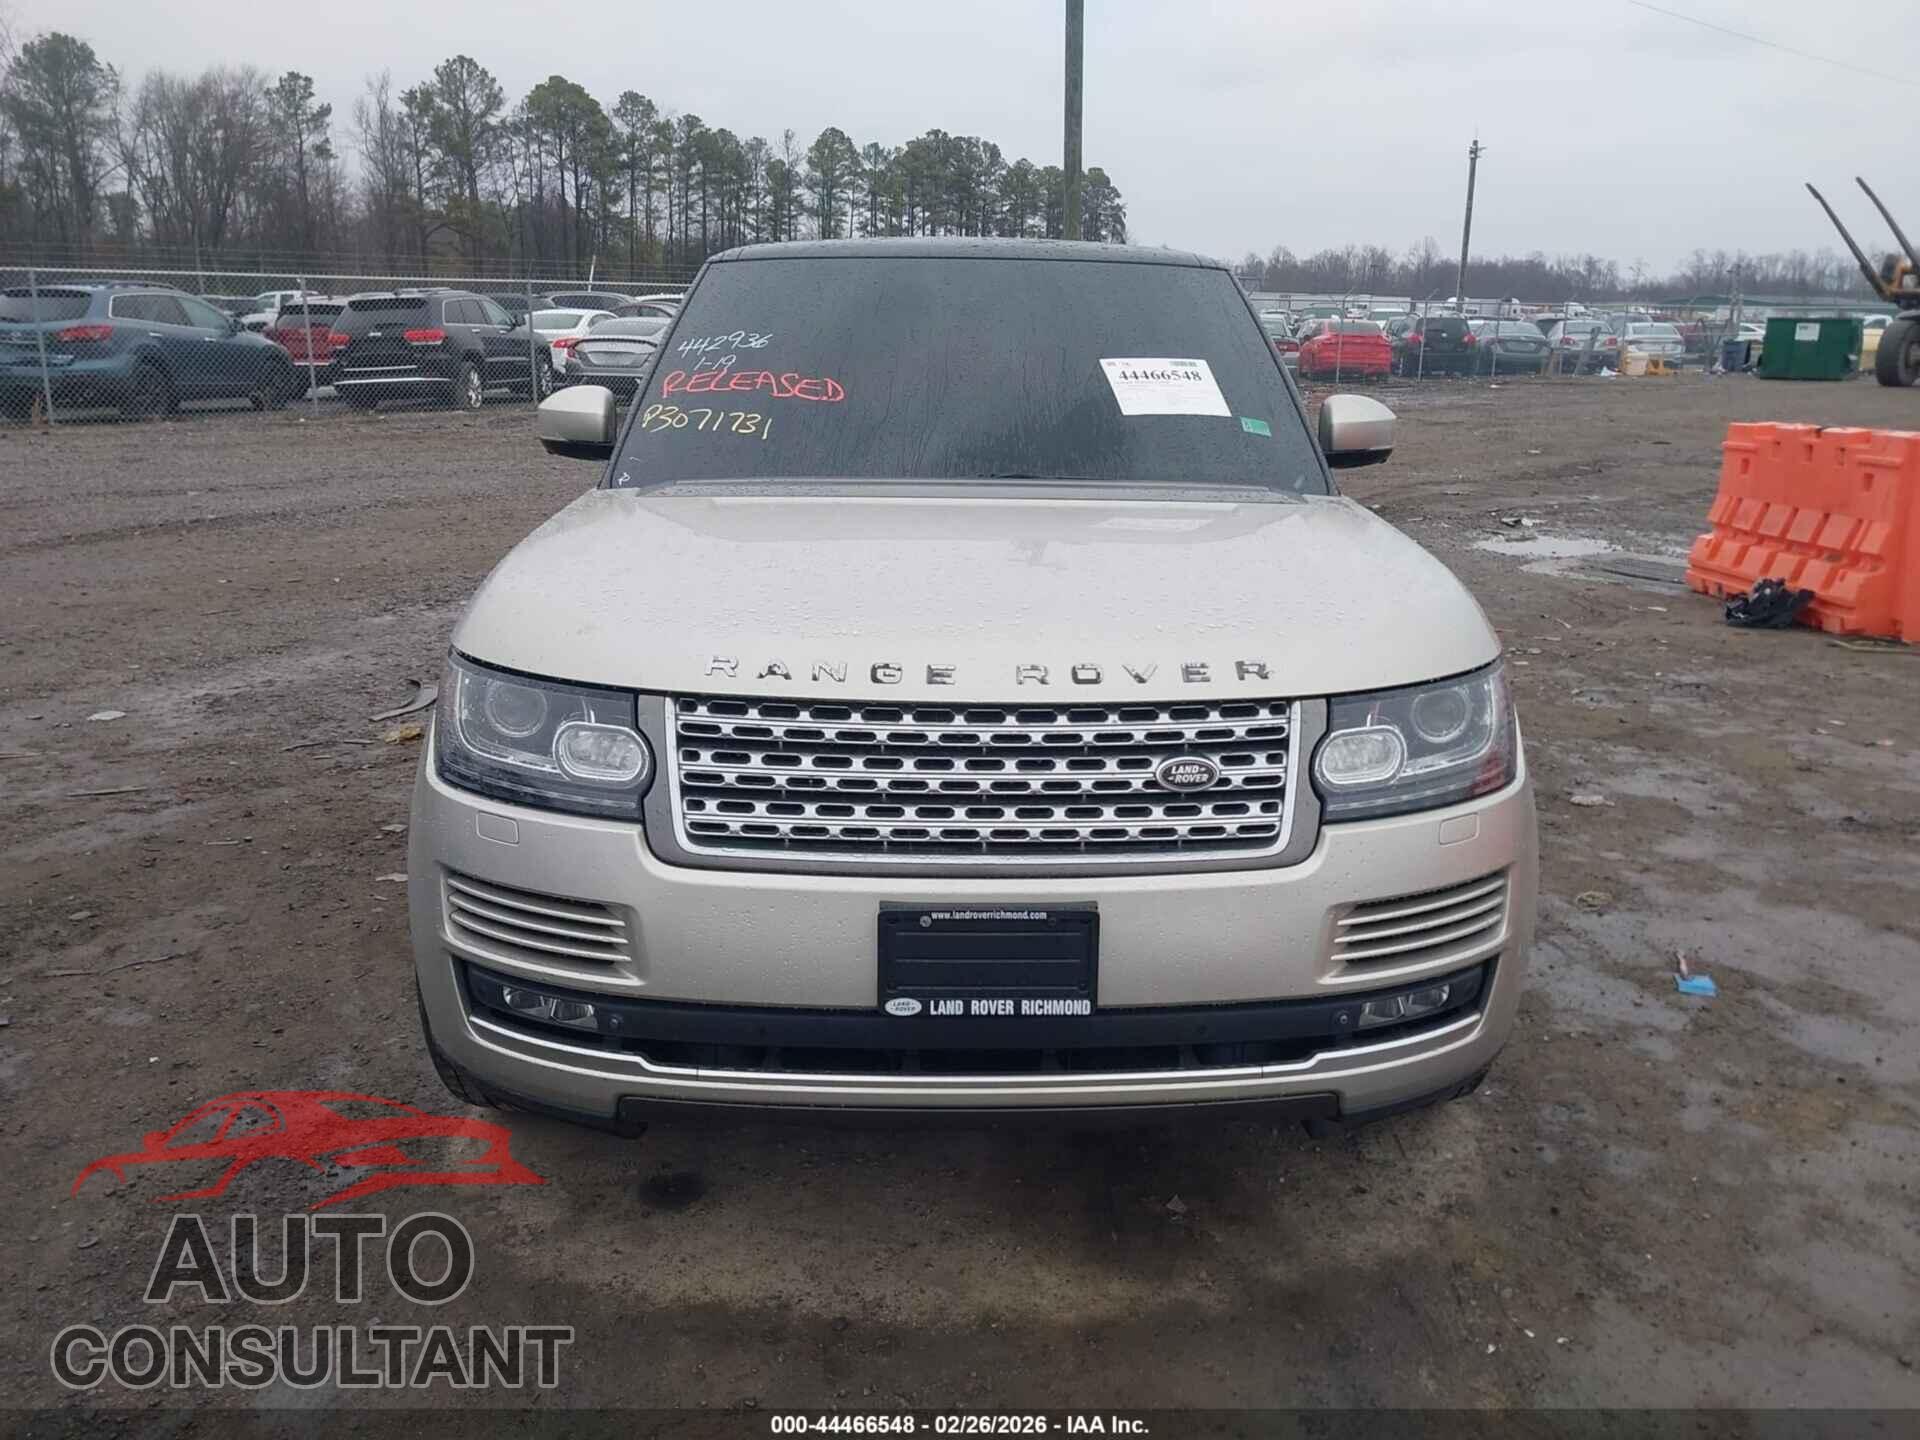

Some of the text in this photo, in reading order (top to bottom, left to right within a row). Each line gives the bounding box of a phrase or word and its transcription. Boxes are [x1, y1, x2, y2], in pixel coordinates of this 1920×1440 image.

[1118, 368, 1203, 382] 44466548
[661, 368, 845, 401] RELEASED
[703, 655, 1275, 686] RANGE ROVER
[1171, 764, 1200, 775] LAND
[1174, 773, 1209, 784] ROVER
[931, 910, 1047, 920] www.landroverrichmond.com
[929, 999, 964, 1016] LAND
[971, 999, 1014, 1016] ROVER
[1021, 999, 1091, 1016] RICHMOND
